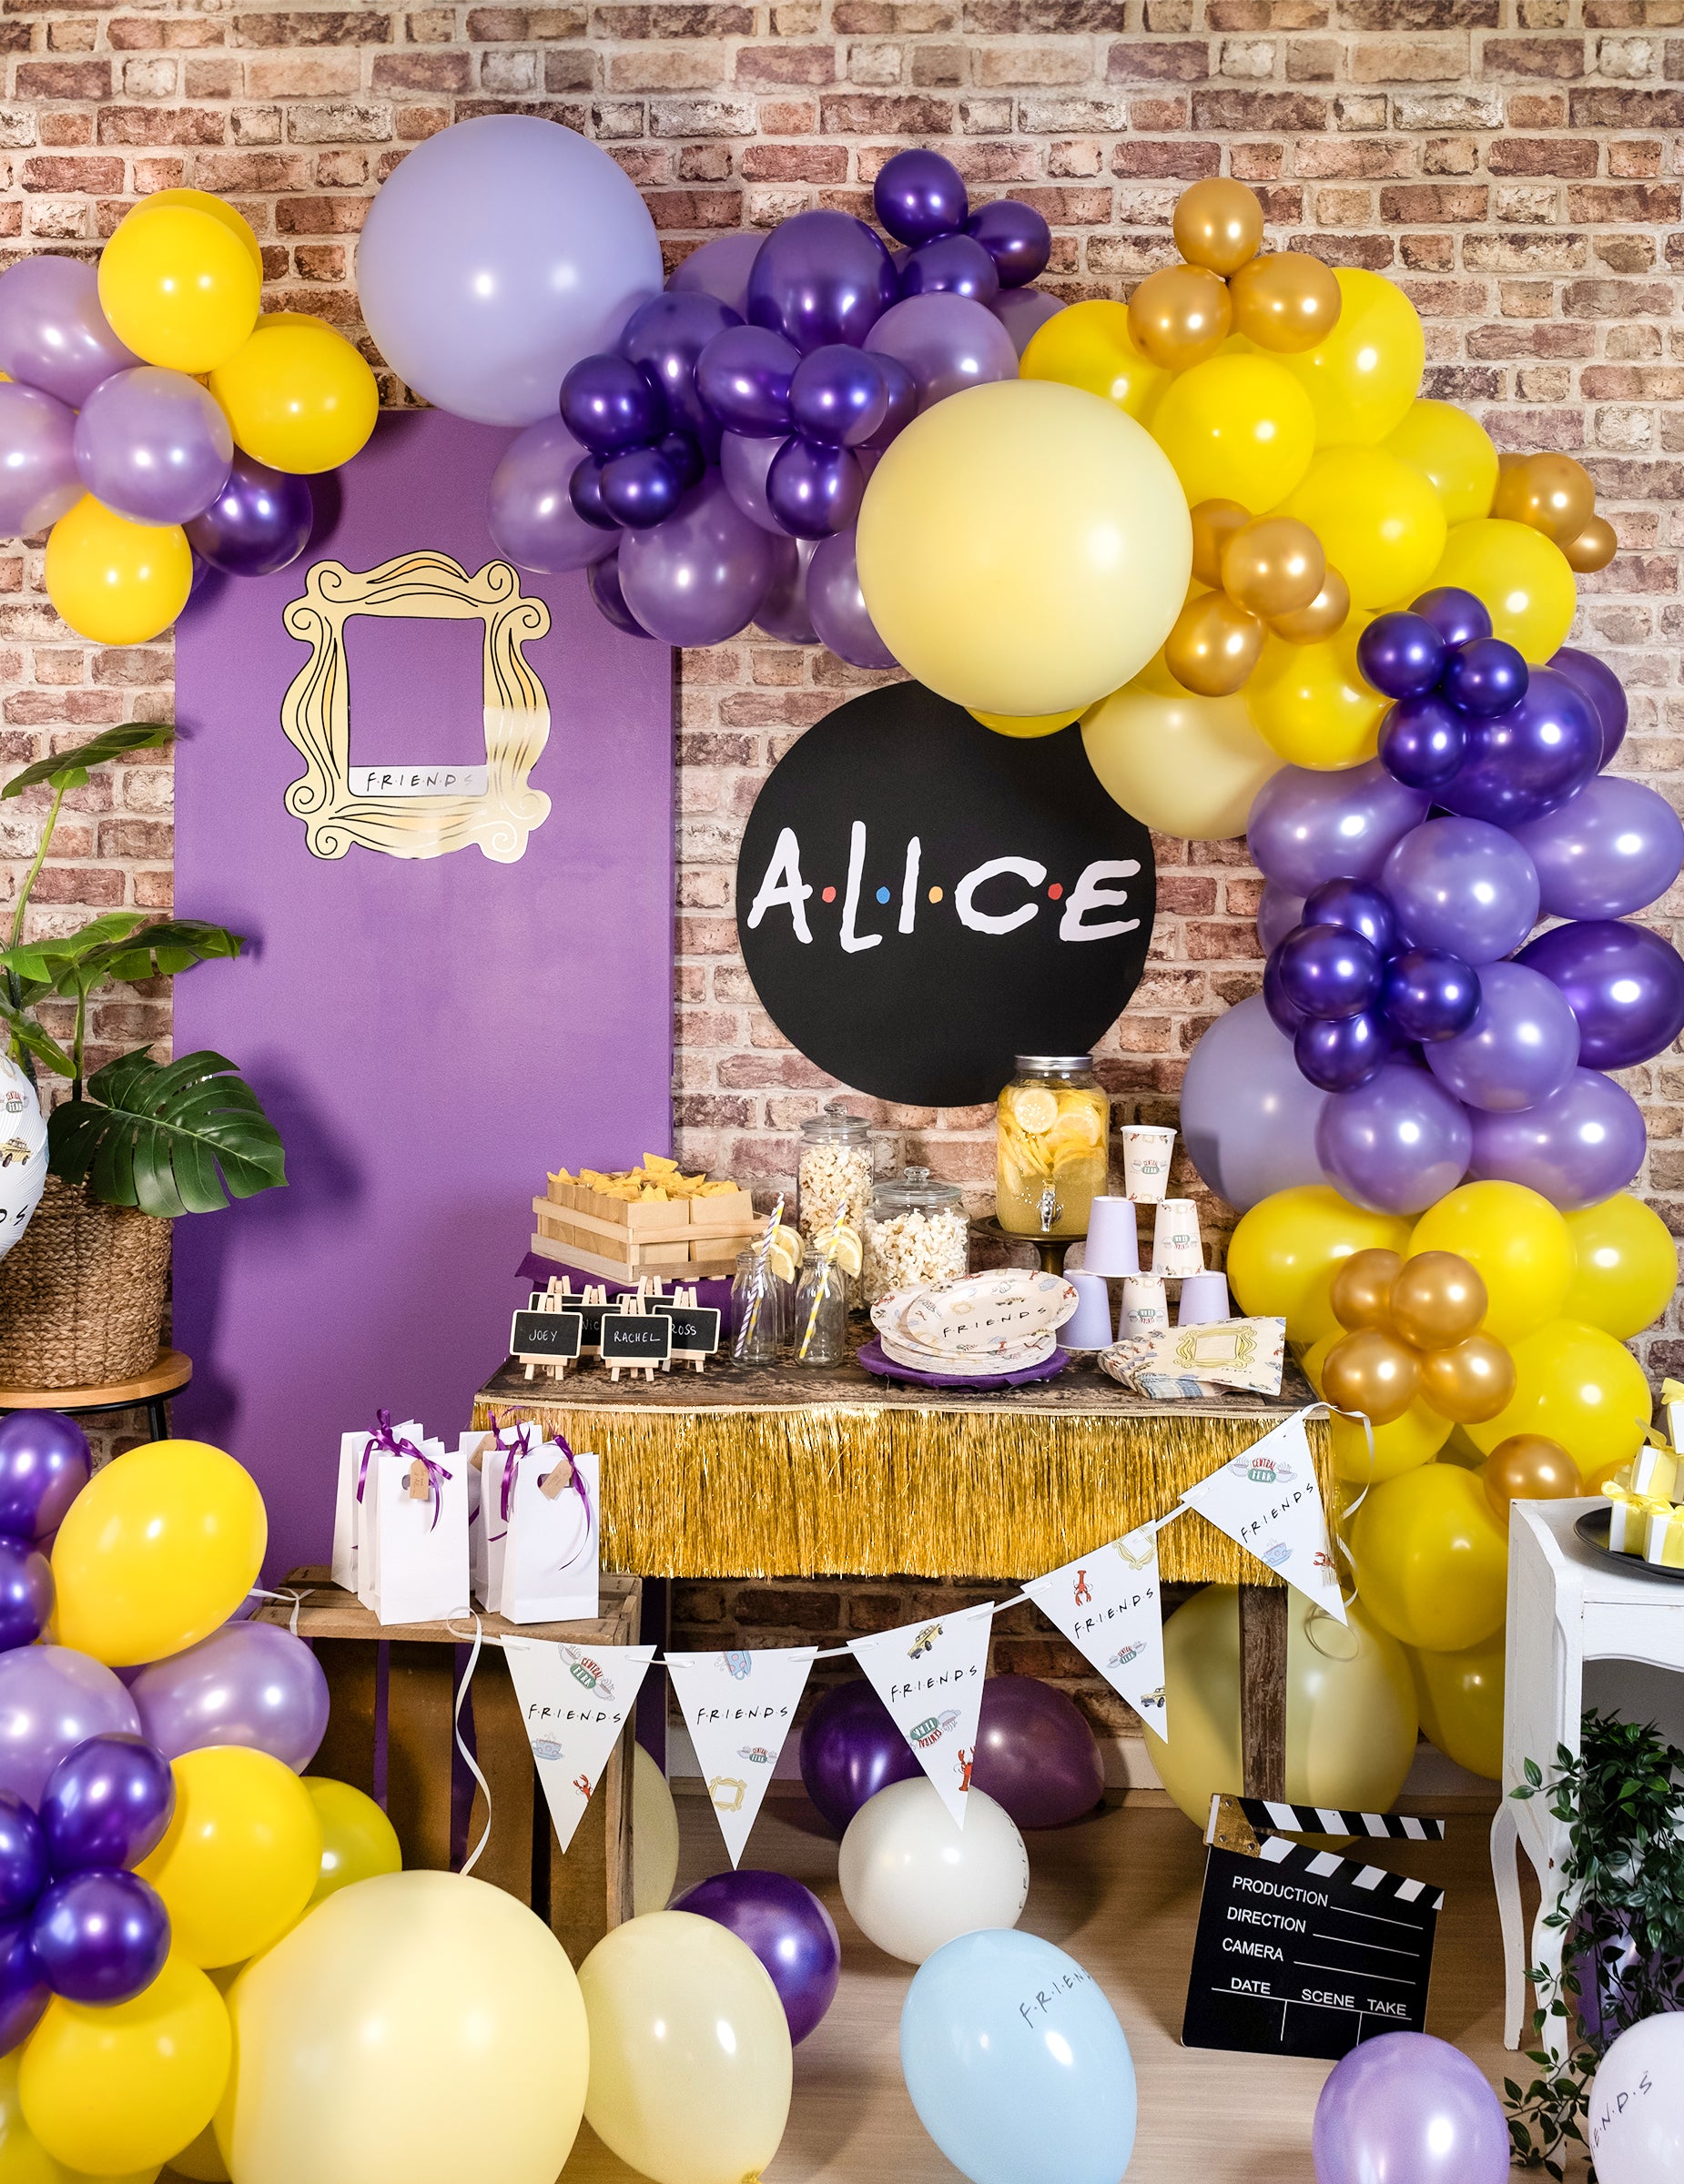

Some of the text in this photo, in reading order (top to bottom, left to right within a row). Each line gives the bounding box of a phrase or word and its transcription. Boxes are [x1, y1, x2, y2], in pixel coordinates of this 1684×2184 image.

[529, 1330, 558, 1341] JOEY
[614, 1330, 661, 1342] RACHEL
[1233, 1875, 1329, 1907] PRODUCTION
[1226, 1906, 1306, 1934] DIRECTION
[1222, 1937, 1284, 1962] CAMERA
[1231, 1977, 1407, 2017] DATE SCENE TAKE
